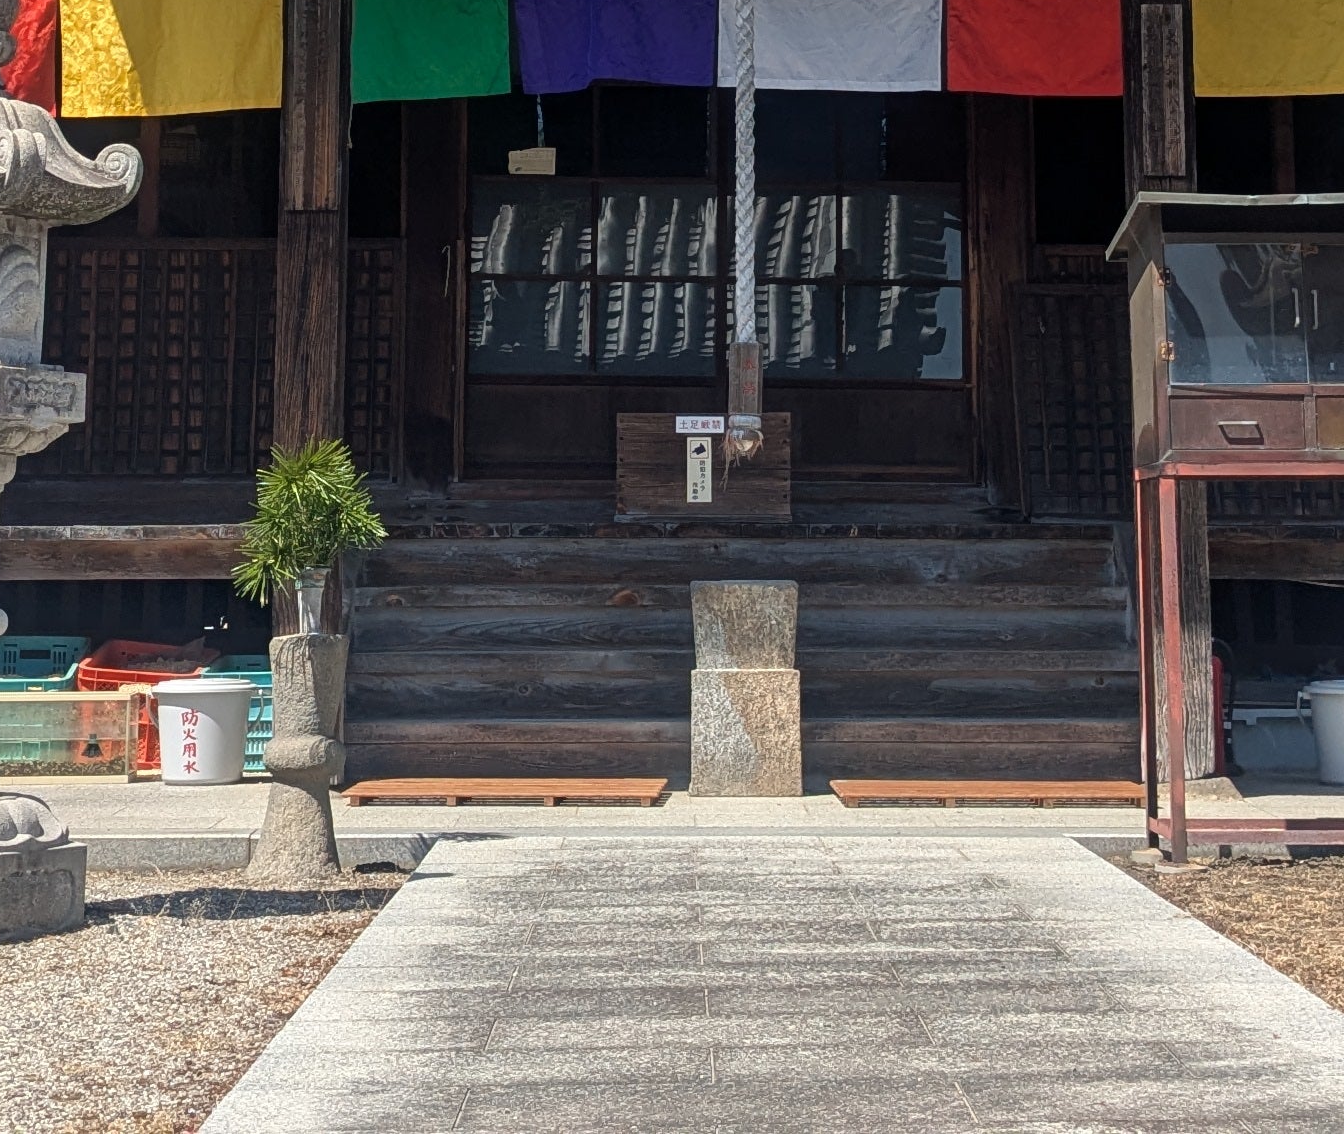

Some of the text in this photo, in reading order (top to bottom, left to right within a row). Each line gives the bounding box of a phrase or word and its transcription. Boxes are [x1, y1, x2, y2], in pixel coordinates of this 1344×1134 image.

[678, 419, 722, 430] 土足厳禁
[181, 708, 200, 774] 防火用水
